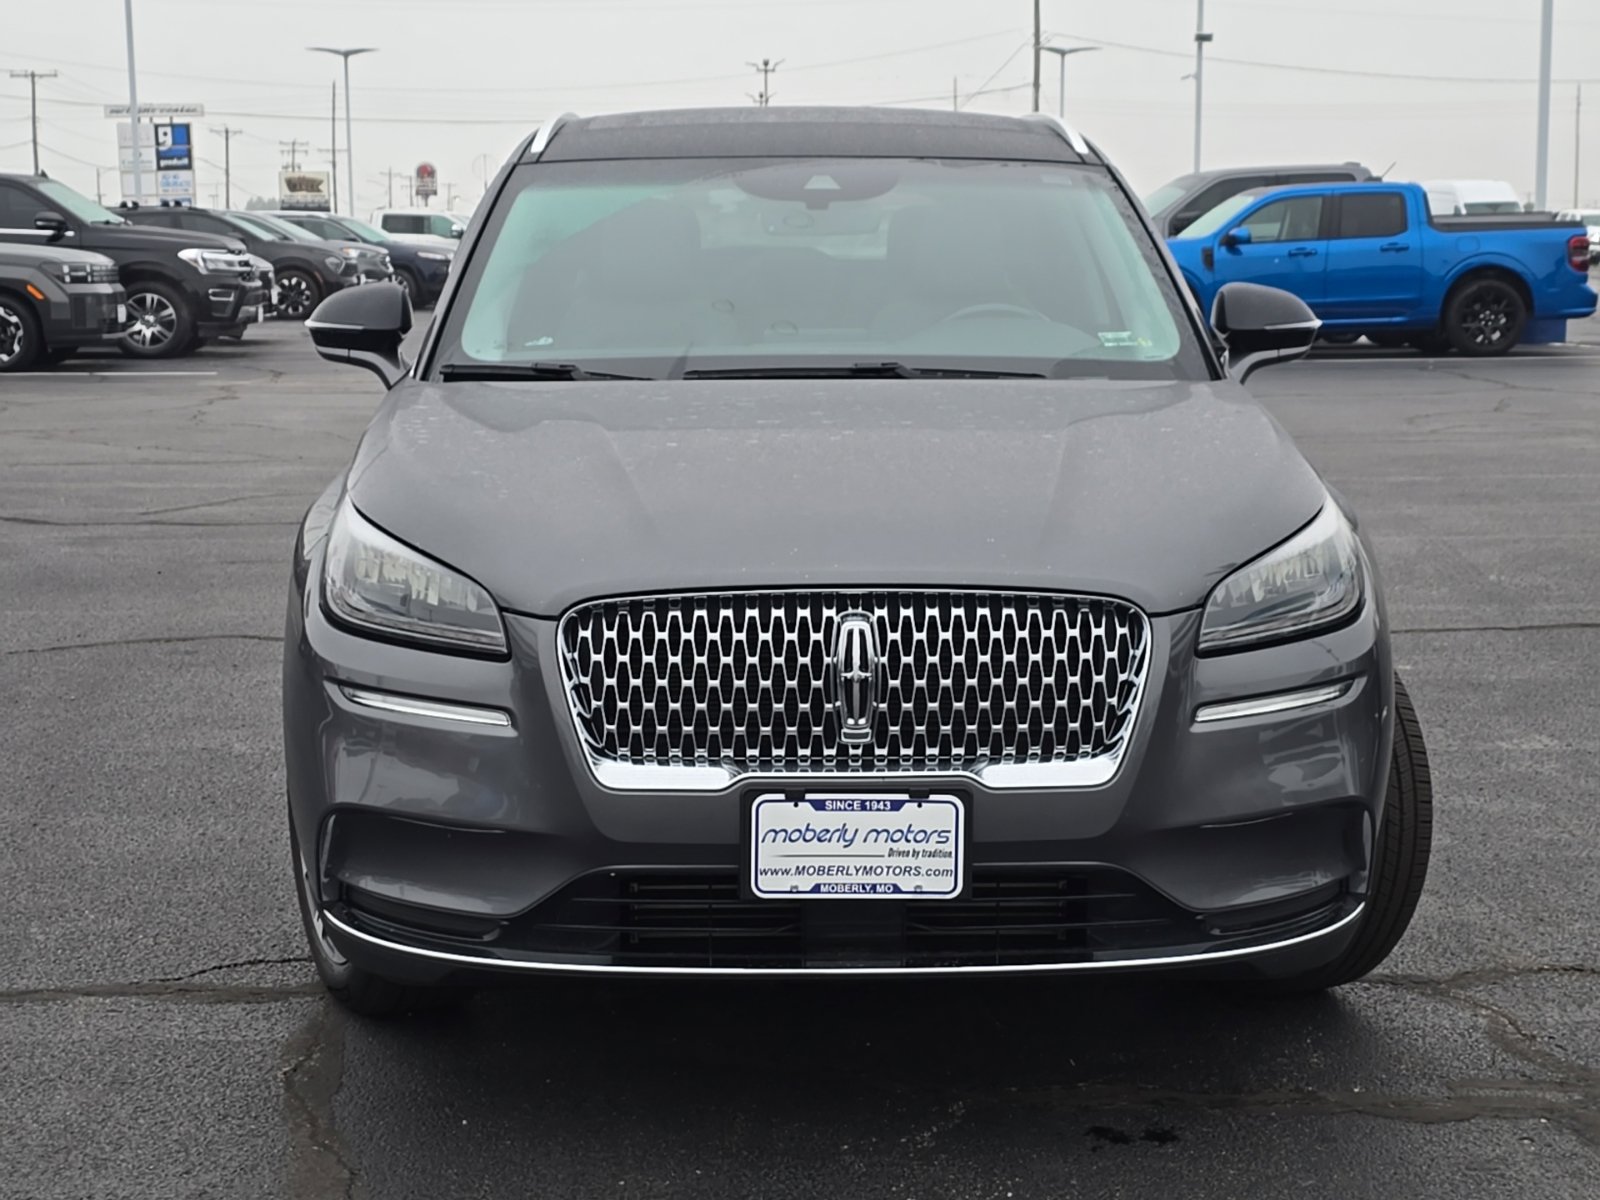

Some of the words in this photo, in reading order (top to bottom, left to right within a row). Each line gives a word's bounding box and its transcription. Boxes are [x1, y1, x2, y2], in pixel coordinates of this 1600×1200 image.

[825, 800, 861, 810] SINCE
[865, 800, 891, 810] 1943
[761, 823, 858, 848] moberly
[863, 824, 952, 844] motors
[888, 848, 910, 858] Driven
[912, 848, 920, 860] by
[759, 865, 953, 878] www.MOBERLYMOTORS.com
[820, 884, 874, 894] MOBERLY,
[878, 884, 893, 893] MO
